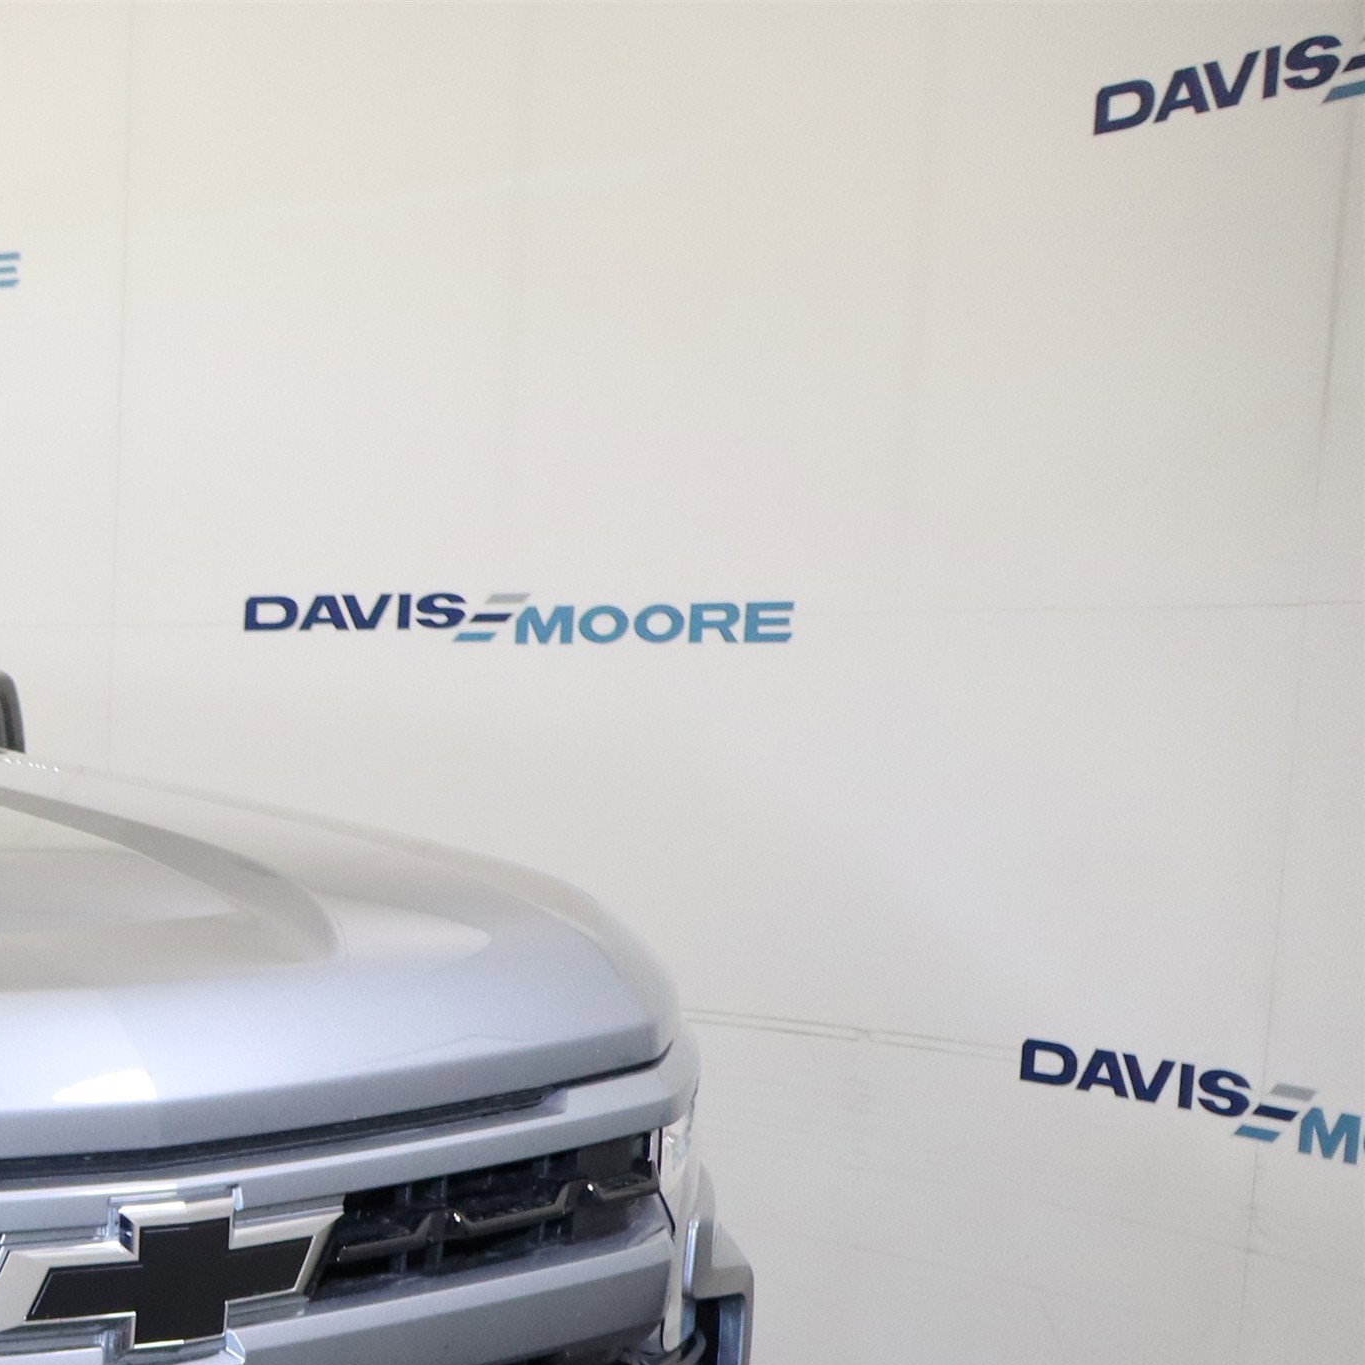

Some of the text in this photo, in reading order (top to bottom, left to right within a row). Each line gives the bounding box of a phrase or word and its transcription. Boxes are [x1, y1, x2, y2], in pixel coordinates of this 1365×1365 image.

[1094, 35, 1342, 135] DAVIS
[243, 593, 795, 644] DAVIS MOORE
[1020, 1038, 1251, 1118] DAVIS
